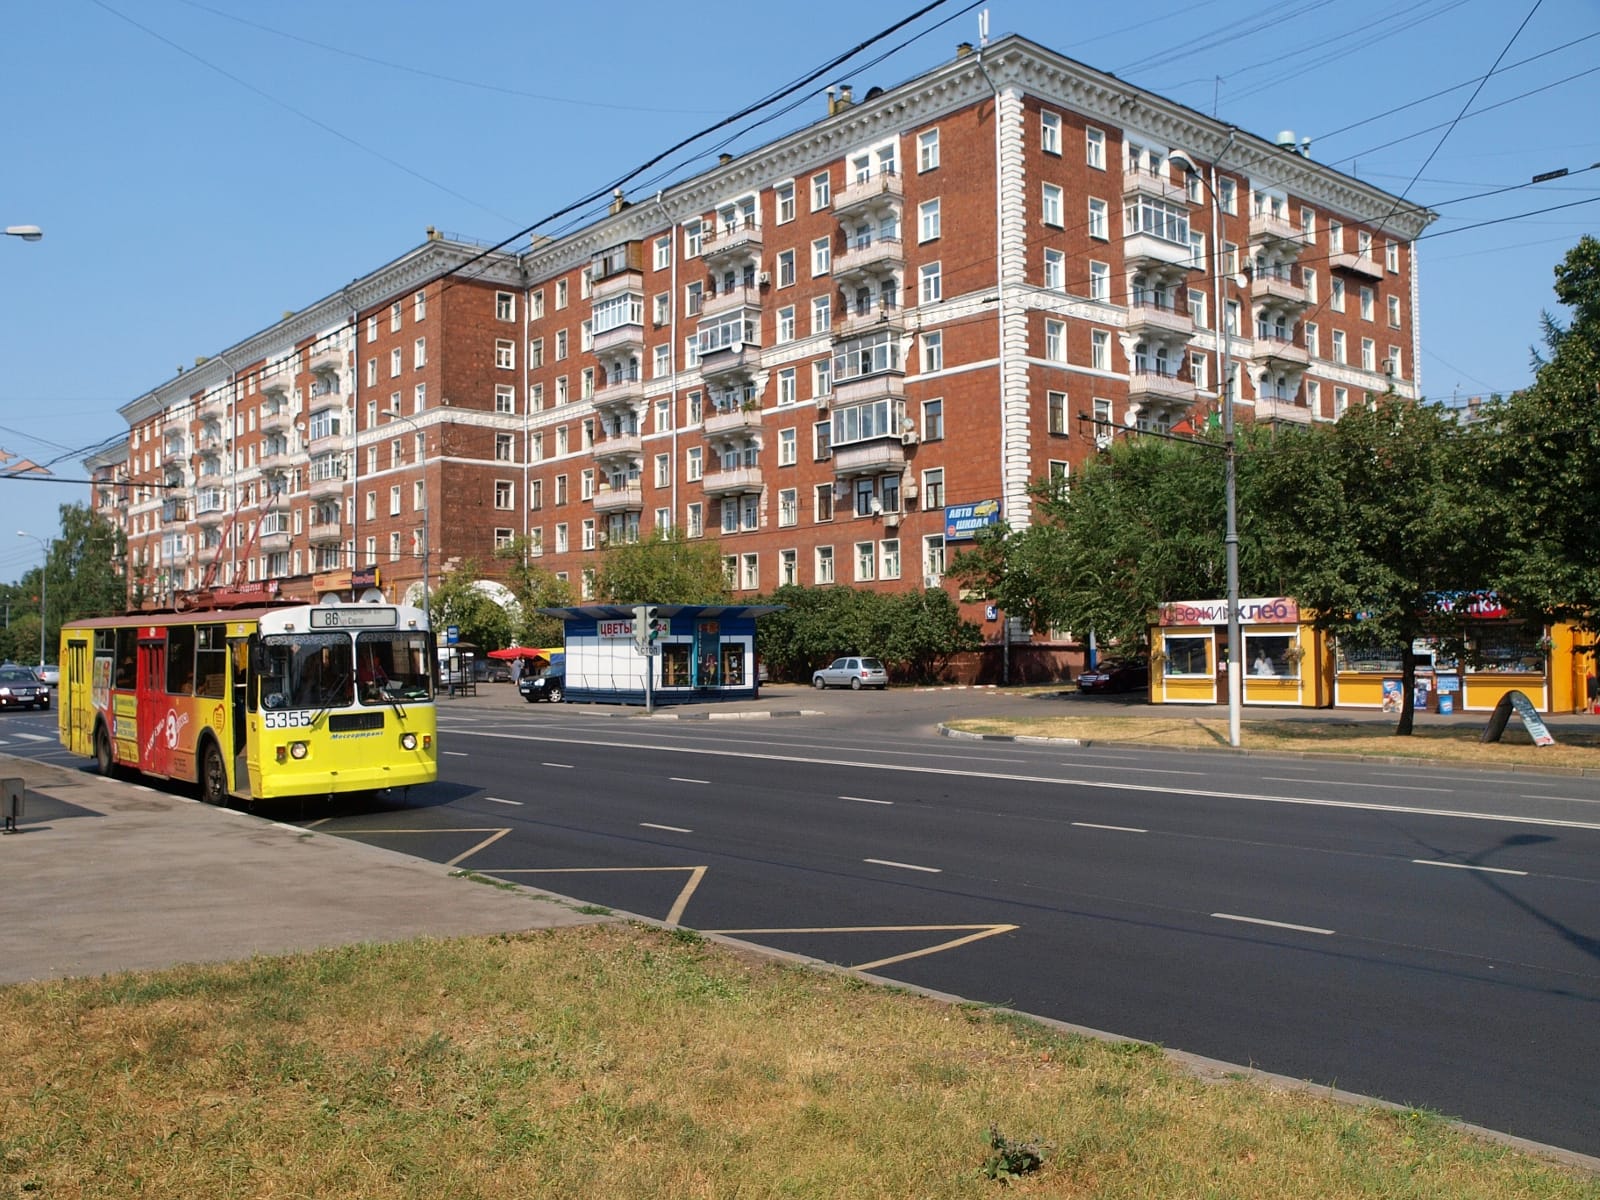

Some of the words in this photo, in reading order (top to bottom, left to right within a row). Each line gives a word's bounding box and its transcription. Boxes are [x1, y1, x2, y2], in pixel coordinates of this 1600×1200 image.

[948, 507, 972, 519] АВТО
[956, 517, 989, 530] ШКОЛА
[325, 612, 339, 626] 86
[600, 622, 633, 636] ЦВЕТЫ
[640, 646, 658, 655] СТОП
[265, 711, 311, 729] 5355
